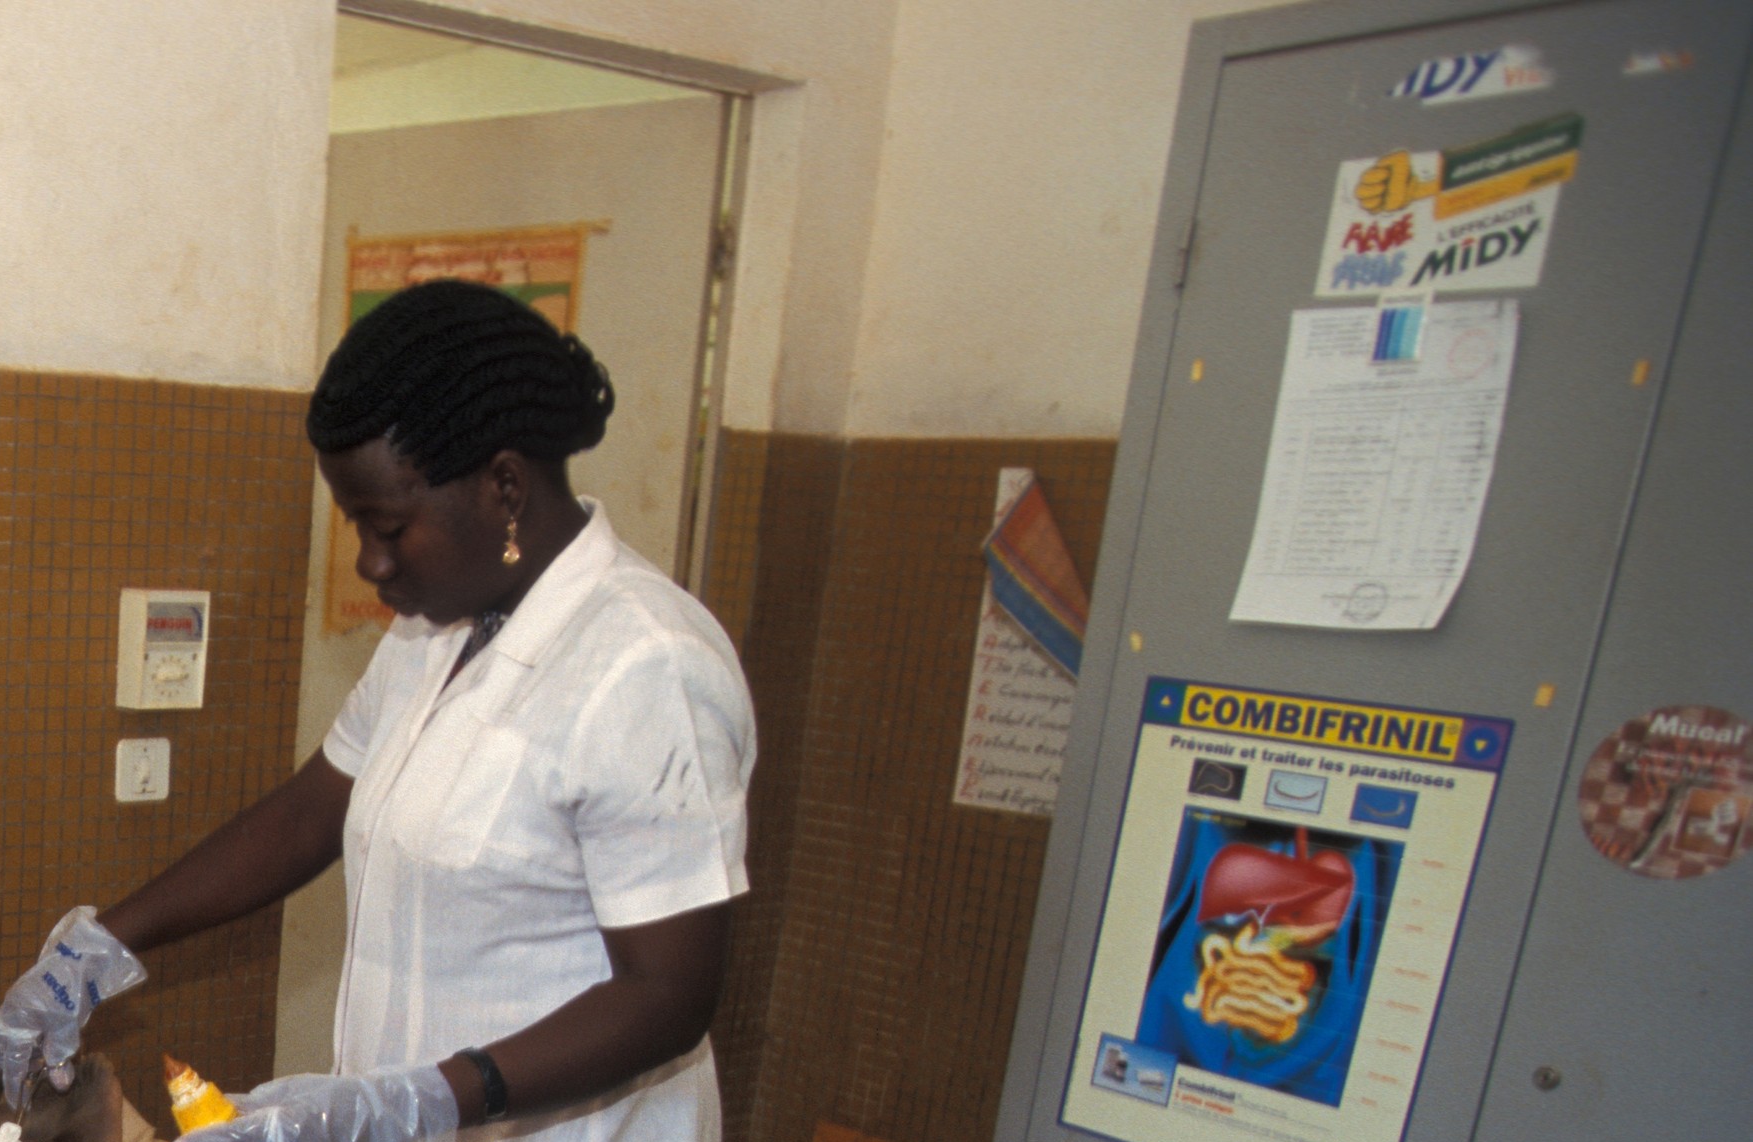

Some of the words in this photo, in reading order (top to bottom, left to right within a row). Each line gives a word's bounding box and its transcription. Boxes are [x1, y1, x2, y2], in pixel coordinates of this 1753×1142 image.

[1387, 50, 1502, 99] IDY
[1187, 691, 1451, 756] COMBIFRINIL
[1170, 734, 1236, 757] Prévenir
[1240, 747, 1257, 760] et
[1262, 748, 1315, 767] traiter
[1319, 756, 1345, 773] les
[1349, 763, 1455, 789] parasitoses
